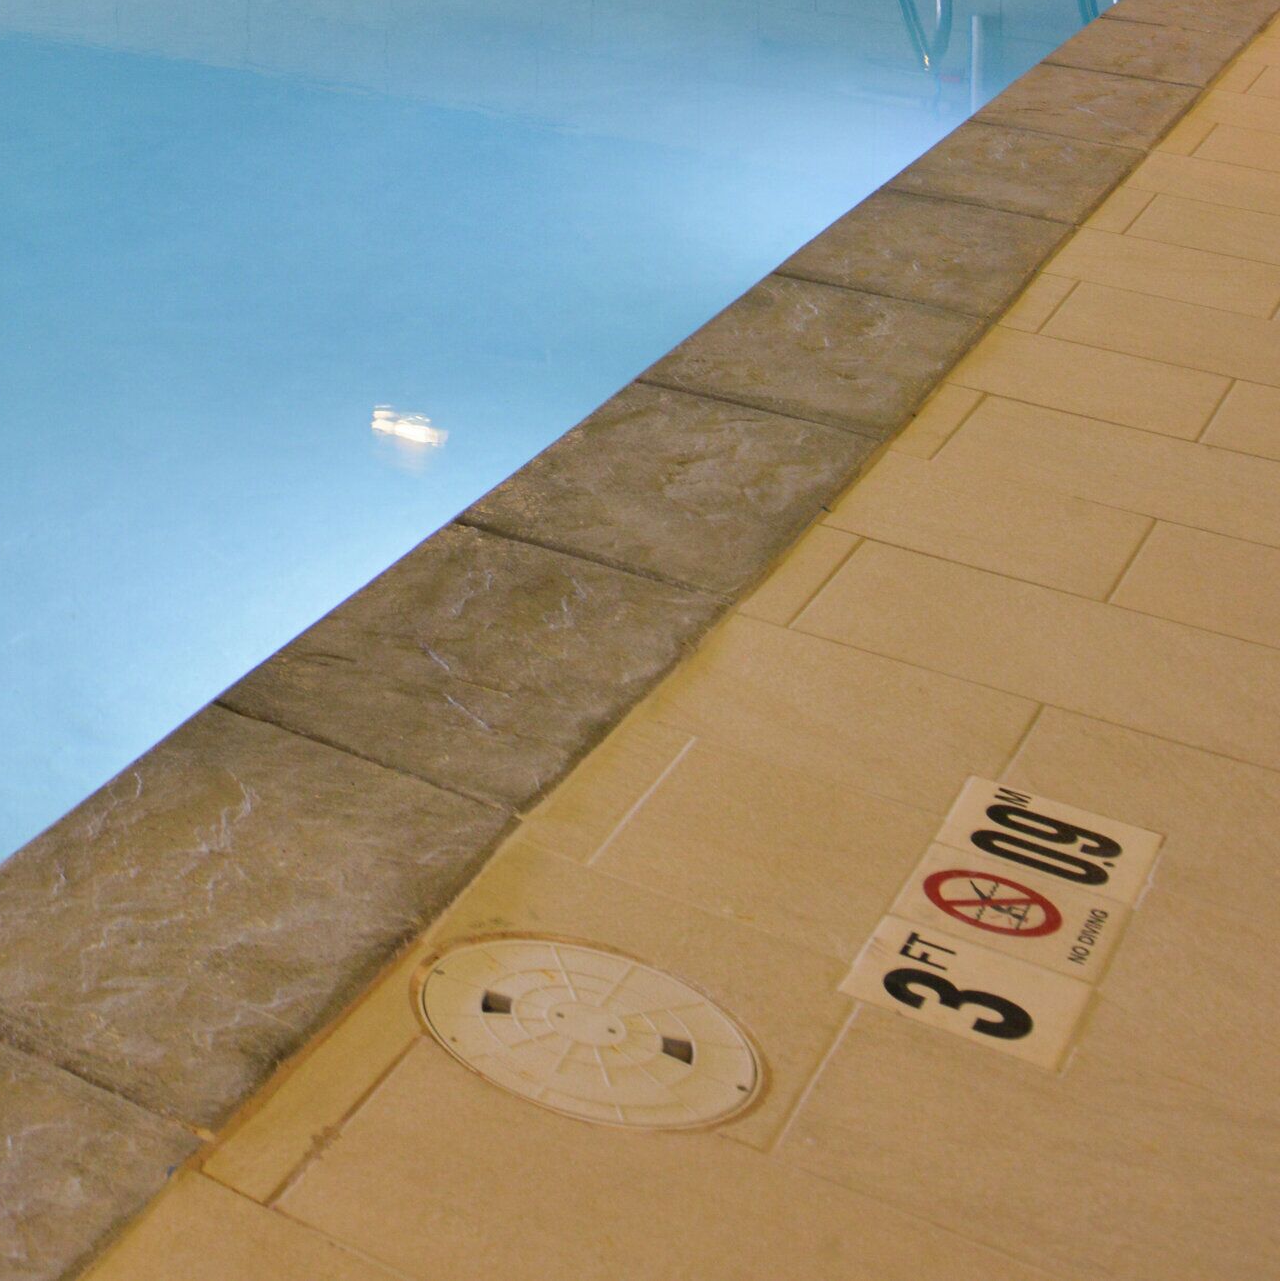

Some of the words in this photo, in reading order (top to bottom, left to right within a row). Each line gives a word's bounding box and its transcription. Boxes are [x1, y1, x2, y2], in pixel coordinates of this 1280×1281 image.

[994, 787, 1032, 808] M
[1077, 909, 1108, 946] DIVING
[899, 932, 957, 970] FT
[1067, 946, 1090, 966] NO
[883, 968, 1033, 1040] 3
